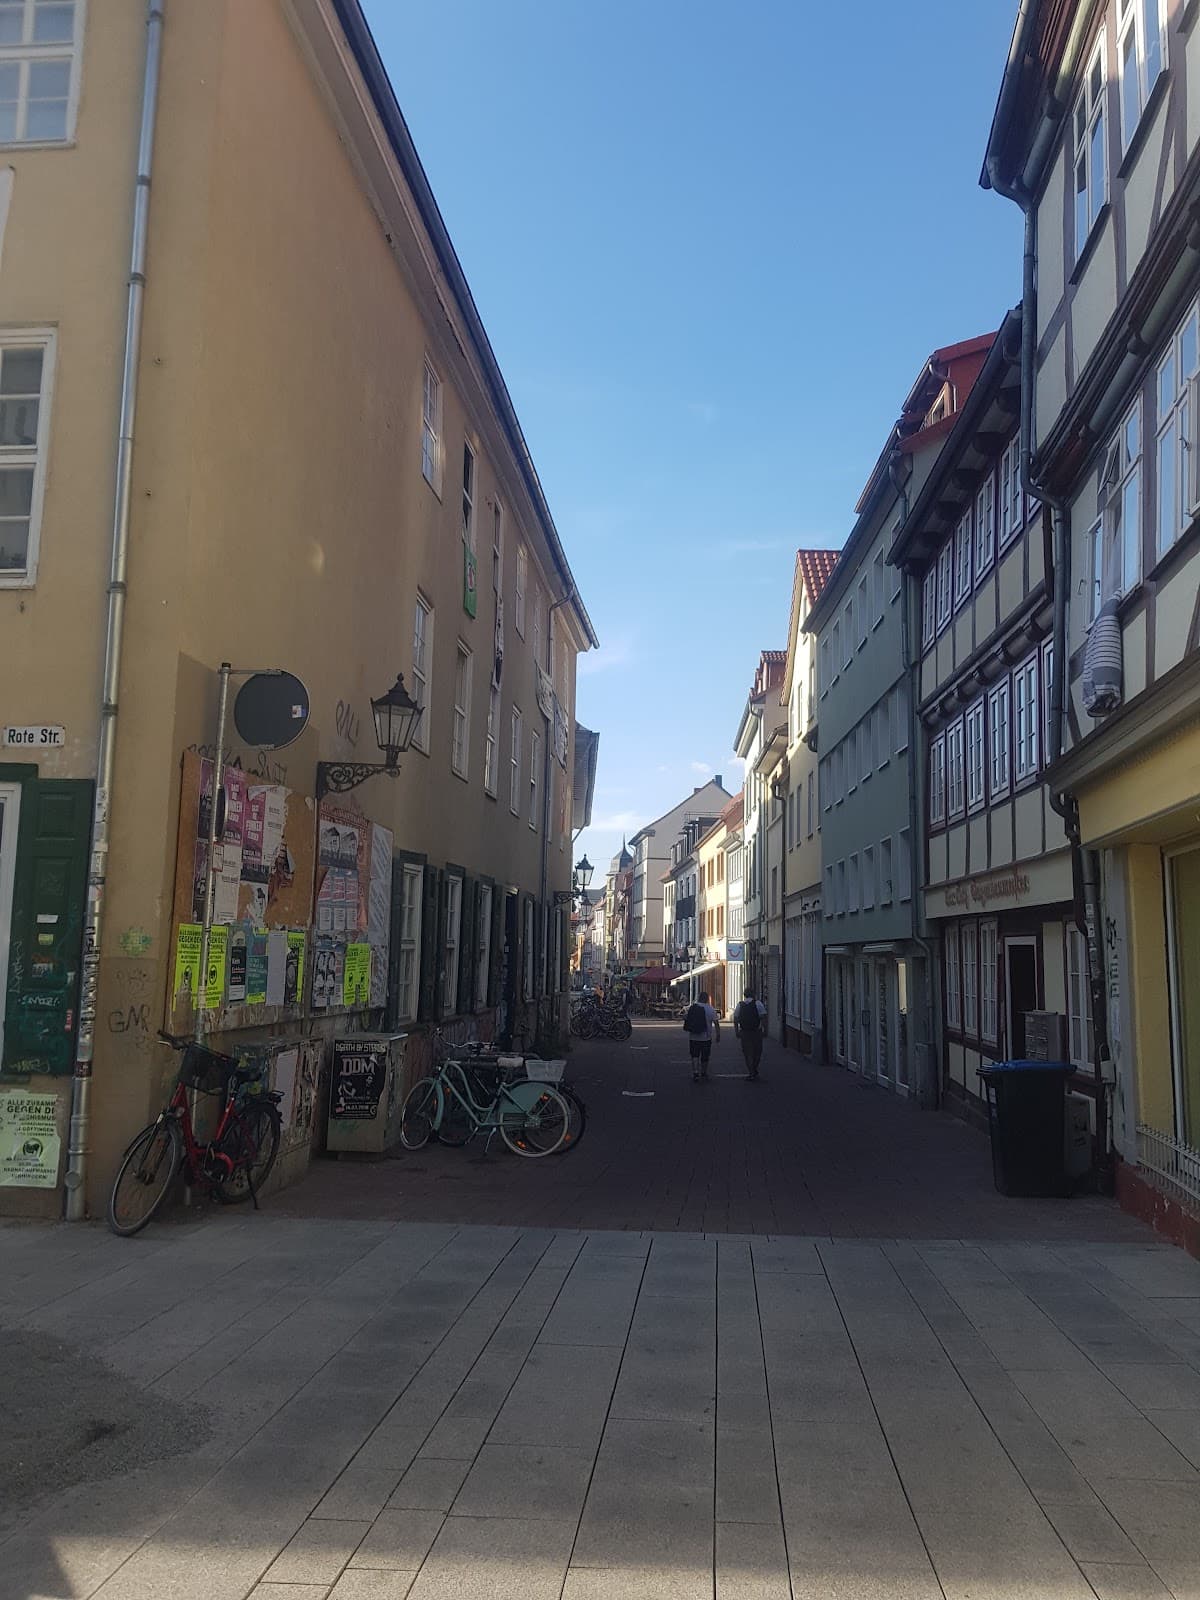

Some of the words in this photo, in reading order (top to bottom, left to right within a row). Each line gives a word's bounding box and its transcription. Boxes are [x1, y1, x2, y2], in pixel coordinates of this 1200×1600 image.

[8, 729, 34, 743] Rote
[40, 728, 60, 743] Str.
[7, 1106, 41, 1114] GEGEN
